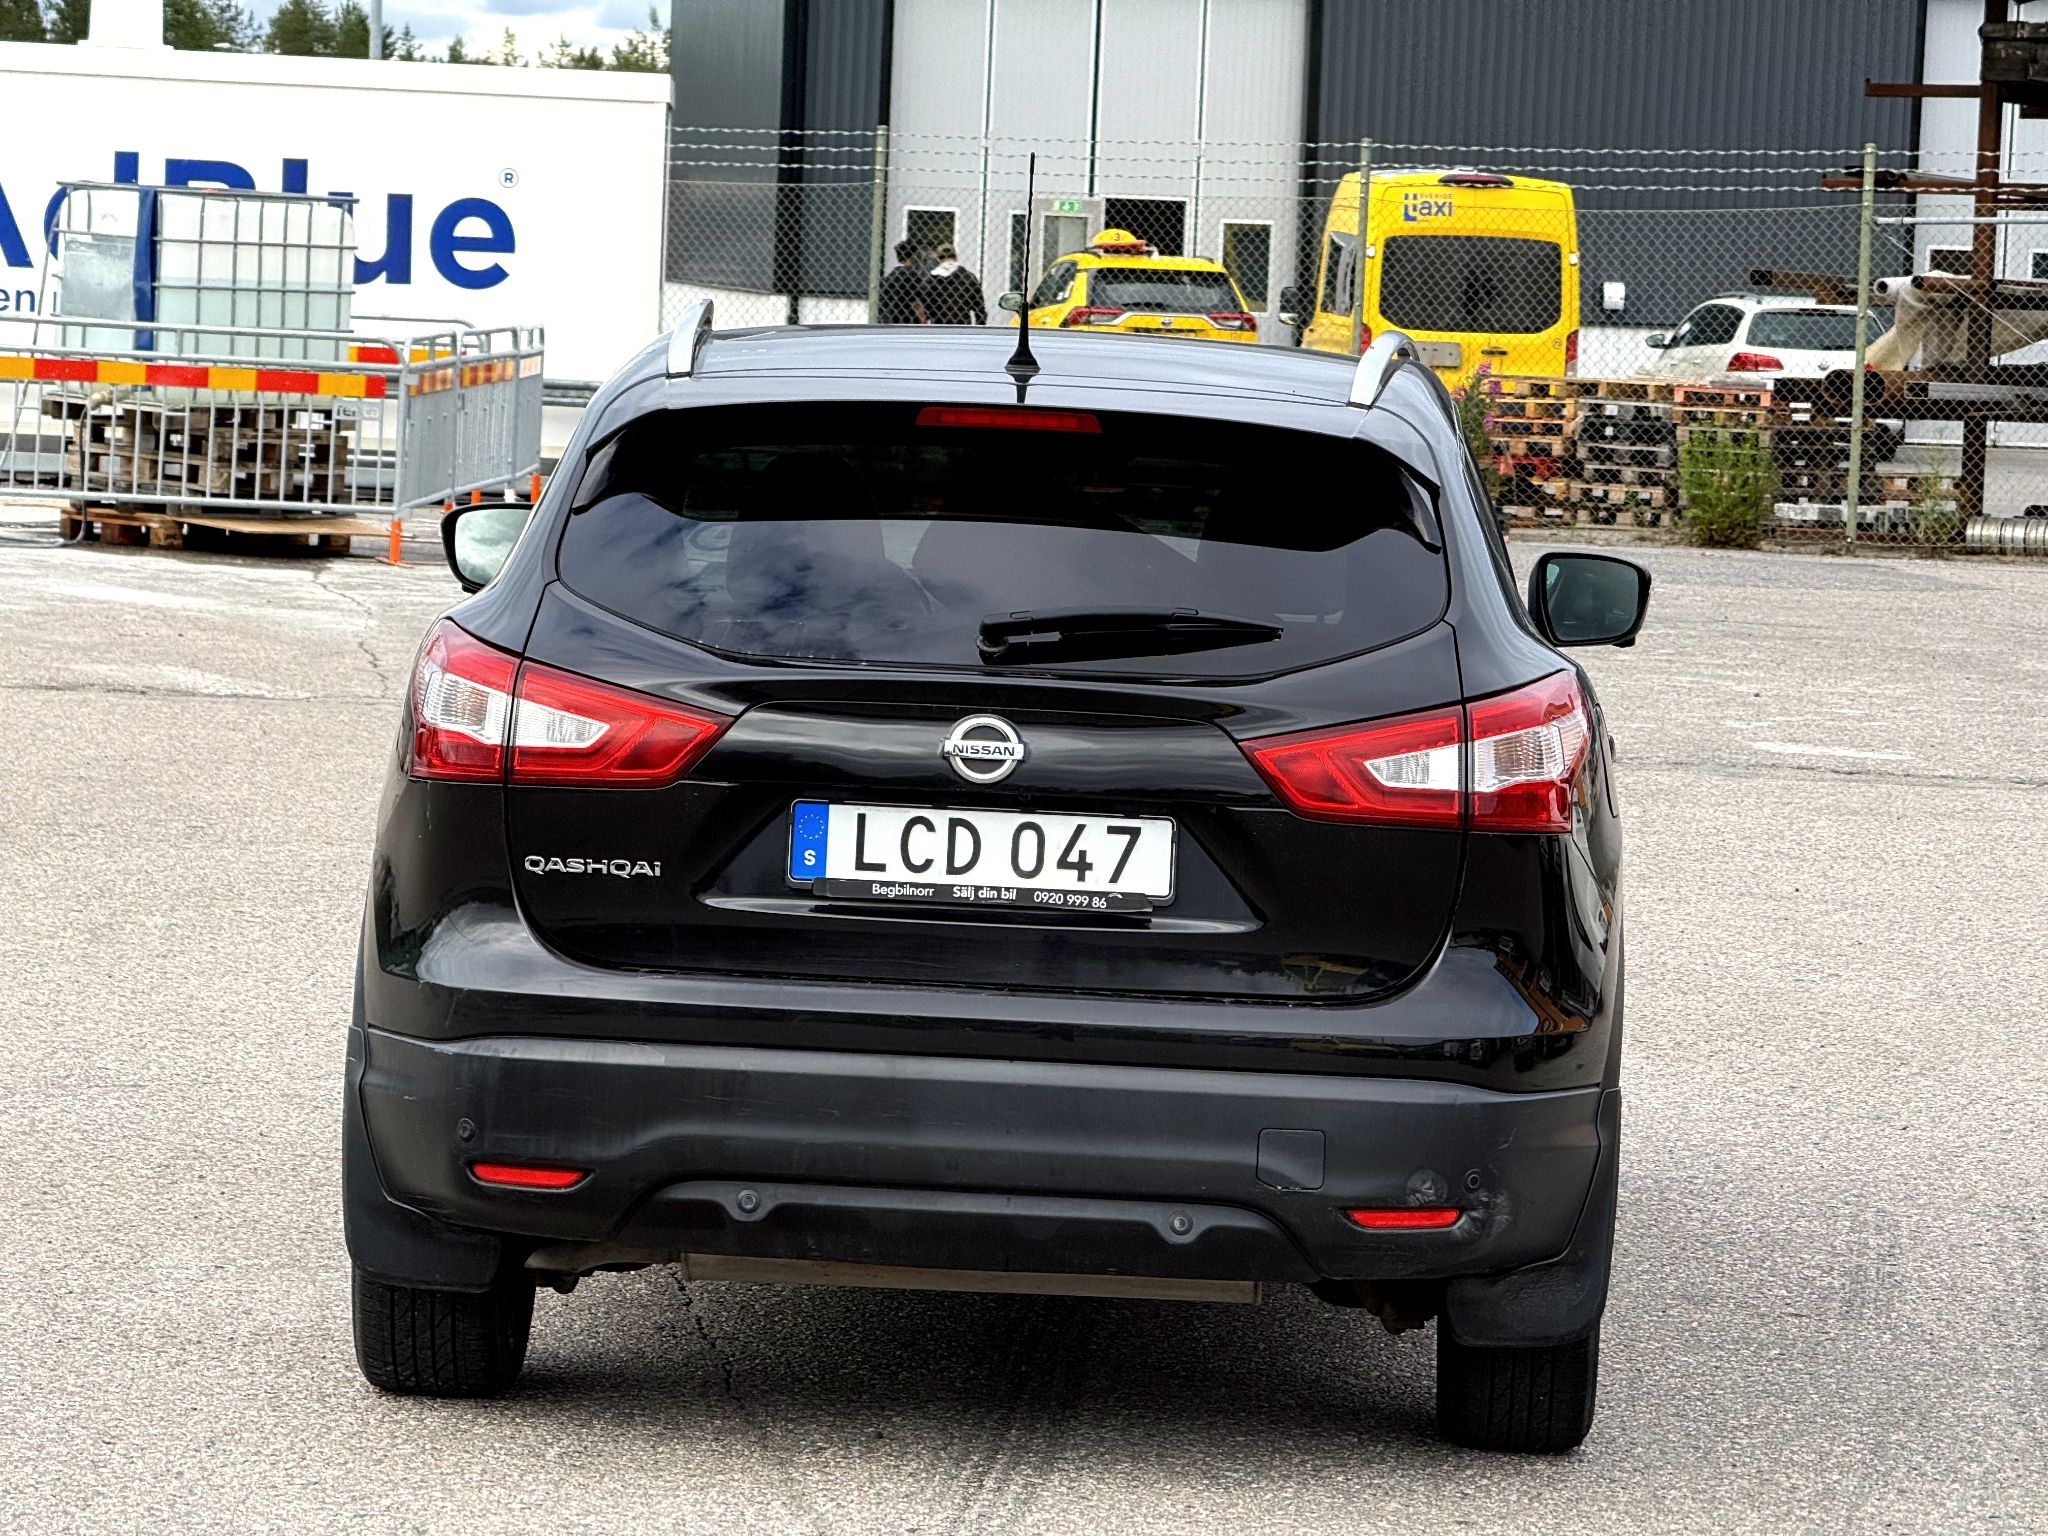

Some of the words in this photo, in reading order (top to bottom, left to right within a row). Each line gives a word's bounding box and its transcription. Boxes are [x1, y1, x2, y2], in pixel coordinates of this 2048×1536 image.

[952, 743, 1016, 757] NISSAN
[803, 849, 816, 866] S
[854, 812, 982, 876] LCD
[1010, 820, 1142, 884] 047
[524, 855, 661, 878] QASHQAI
[872, 884, 934, 898] Begbilnorr
[953, 886, 975, 900] Sälj
[978, 887, 997, 898] din
[1001, 888, 1016, 900] bil
[1034, 891, 1063, 904] 0920
[1067, 894, 1089, 906] 999
[1092, 897, 1106, 908] 86
